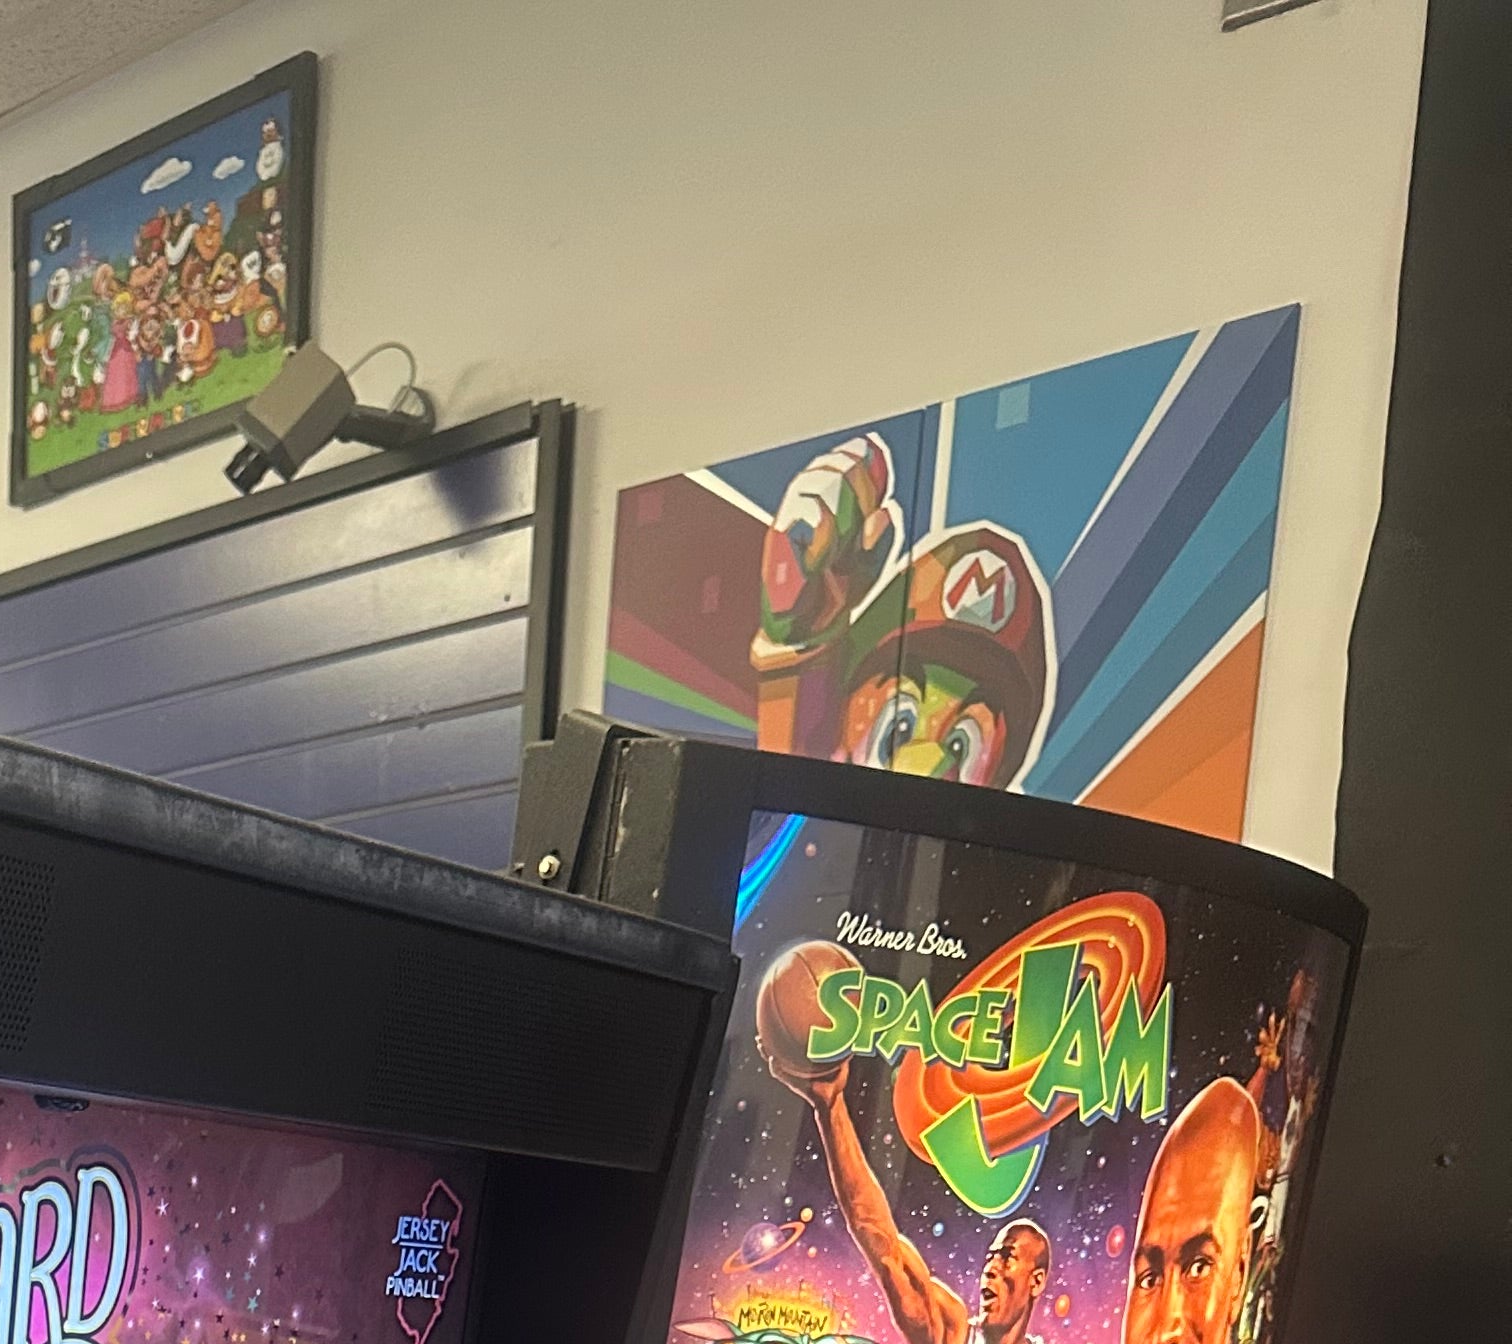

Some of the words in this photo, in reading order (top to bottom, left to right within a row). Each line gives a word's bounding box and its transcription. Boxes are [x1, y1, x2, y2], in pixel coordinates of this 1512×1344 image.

[836, 911, 915, 953] Warner
[916, 924, 968, 960] Bros.
[807, 969, 1010, 1067] SPACE
[921, 941, 1172, 1216] JAM
[392, 1216, 450, 1244] JERSEY
[394, 1248, 439, 1276] JACK
[386, 1276, 439, 1299] PINBALL
